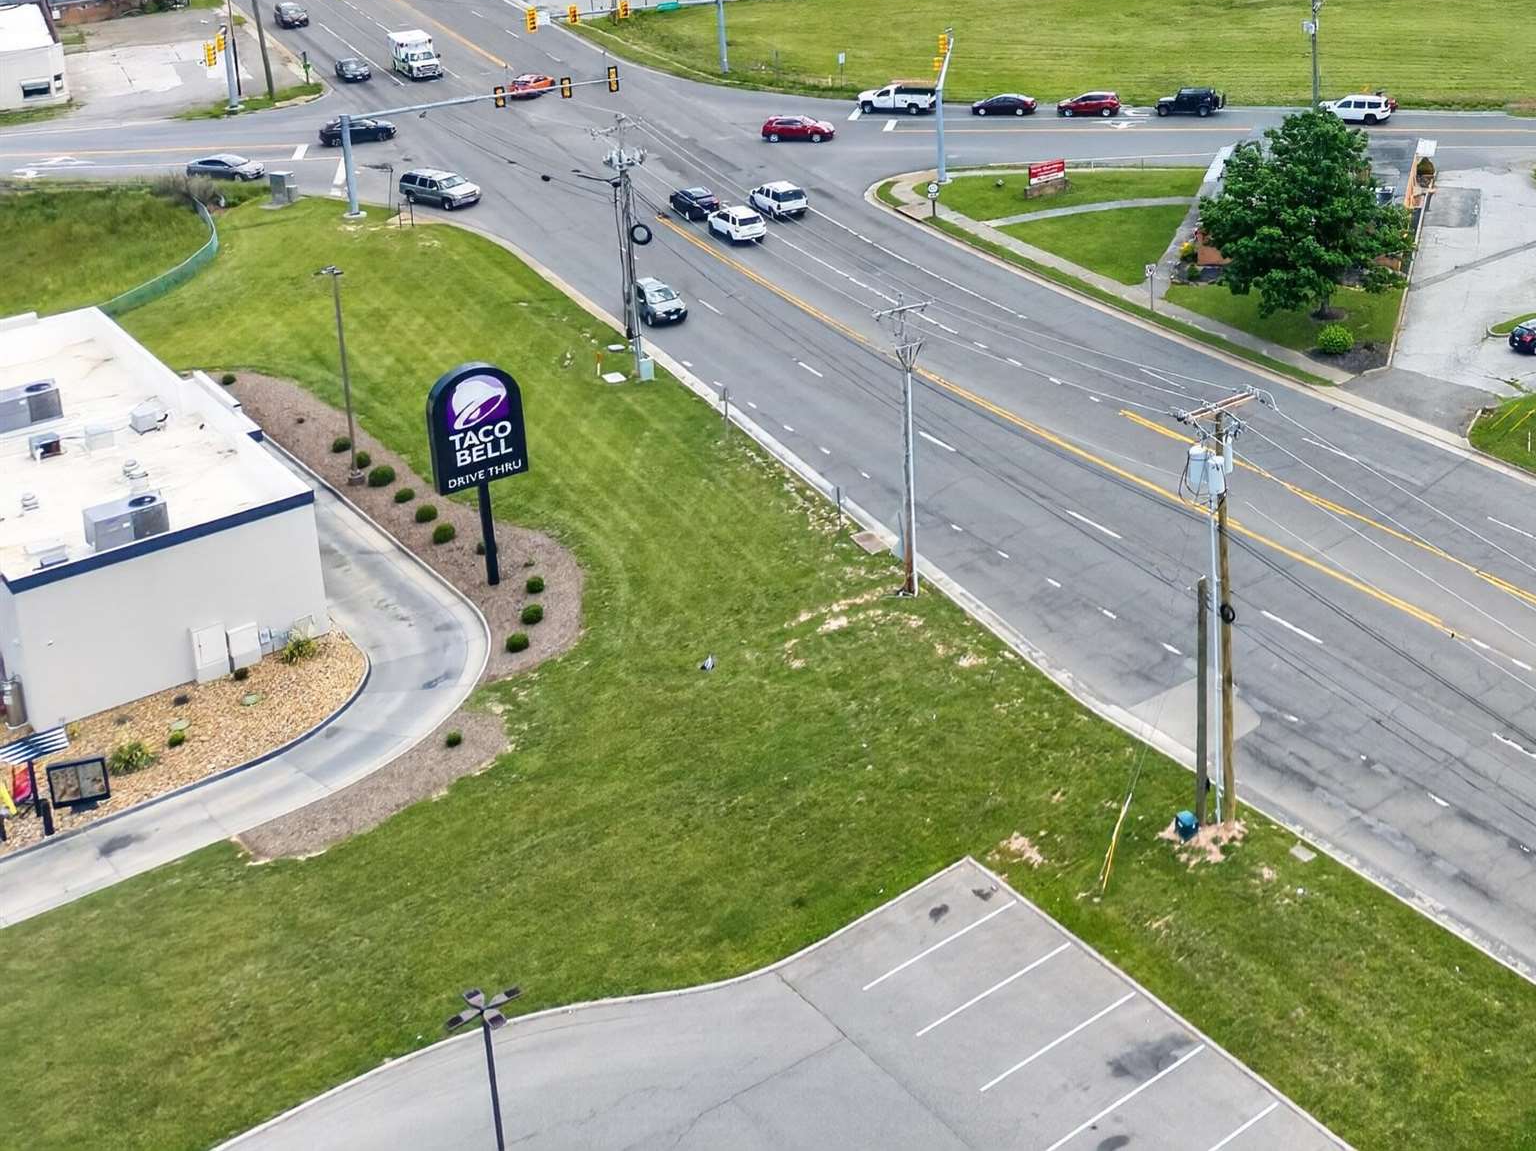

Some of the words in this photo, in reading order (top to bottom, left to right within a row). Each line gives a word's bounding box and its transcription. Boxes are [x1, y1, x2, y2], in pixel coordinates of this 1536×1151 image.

[449, 421, 512, 451] TACO
[456, 439, 513, 467] BELL
[448, 469, 485, 489] DRIVE
[487, 459, 522, 477] THRU
